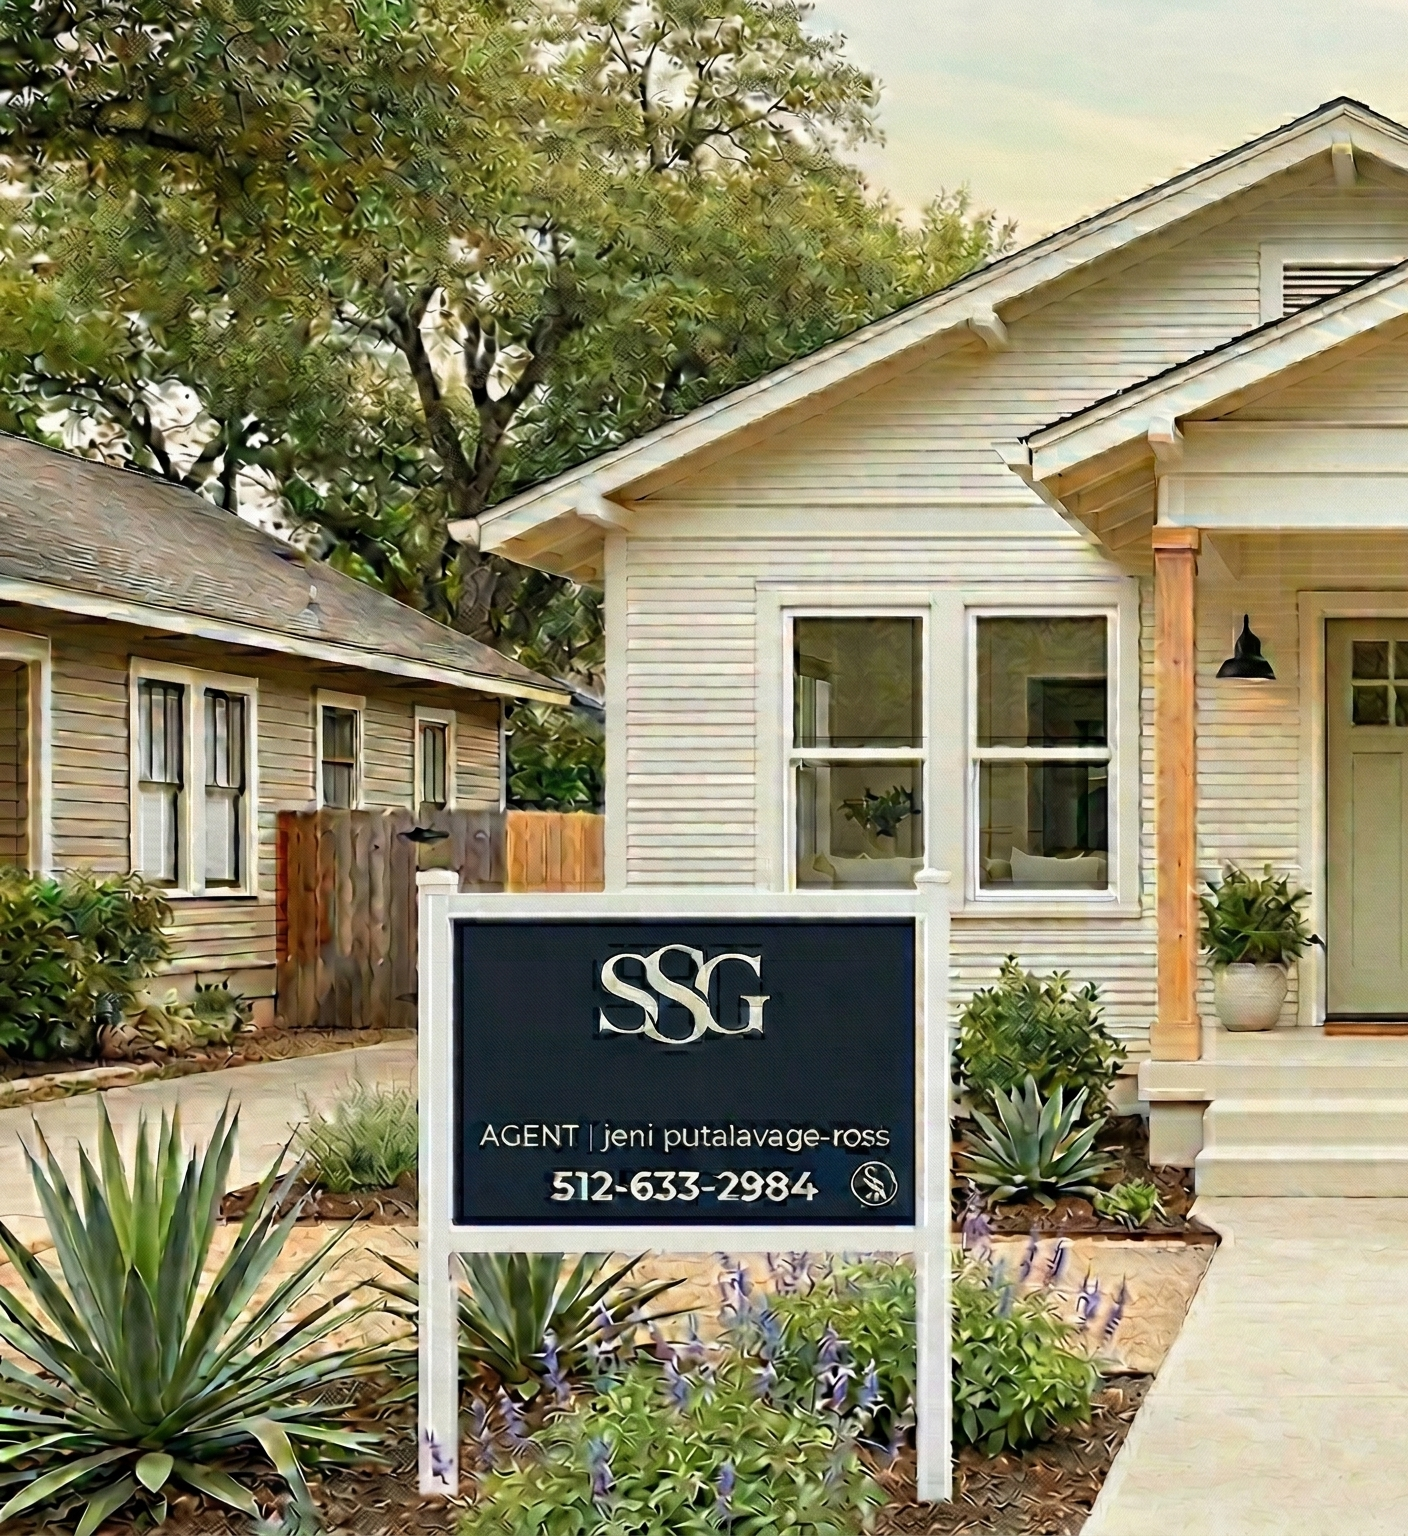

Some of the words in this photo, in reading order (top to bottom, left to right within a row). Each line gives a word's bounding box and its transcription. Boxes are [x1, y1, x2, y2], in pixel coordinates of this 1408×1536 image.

[599, 943, 771, 1045] SSG
[479, 1123, 580, 1148] AGENT
[599, 1122, 654, 1153] jeni
[663, 1123, 891, 1153] putalavage-ross
[550, 1170, 819, 1202] 512-633-2984
